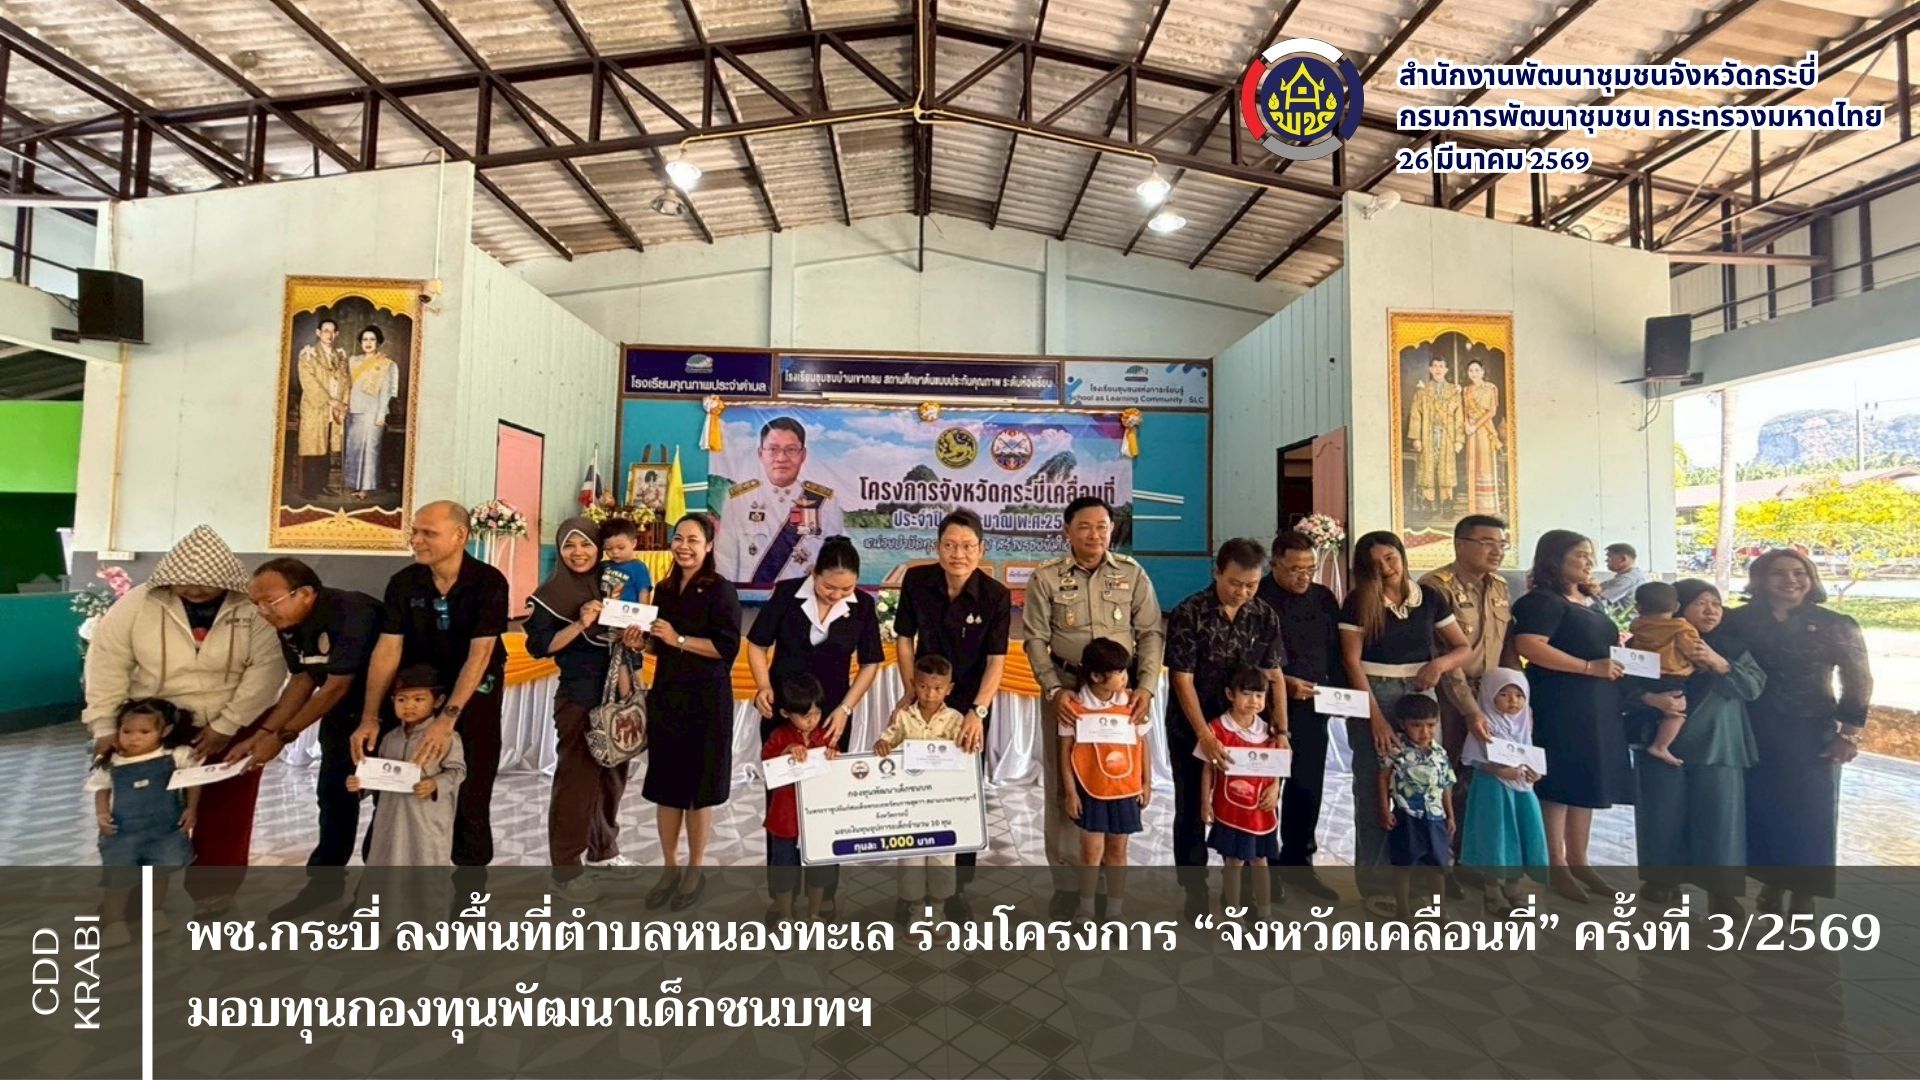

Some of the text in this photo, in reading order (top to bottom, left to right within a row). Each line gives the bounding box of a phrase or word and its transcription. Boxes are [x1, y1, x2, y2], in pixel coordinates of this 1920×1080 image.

[631, 375, 767, 392] โรงเรียนคุณภาพประจำตำบล
[1106, 395, 1138, 403] Learning
[1141, 395, 1182, 404] Community
[1017, 514, 1063, 530] พ.ศ.25
[880, 836, 915, 850] 1,000
